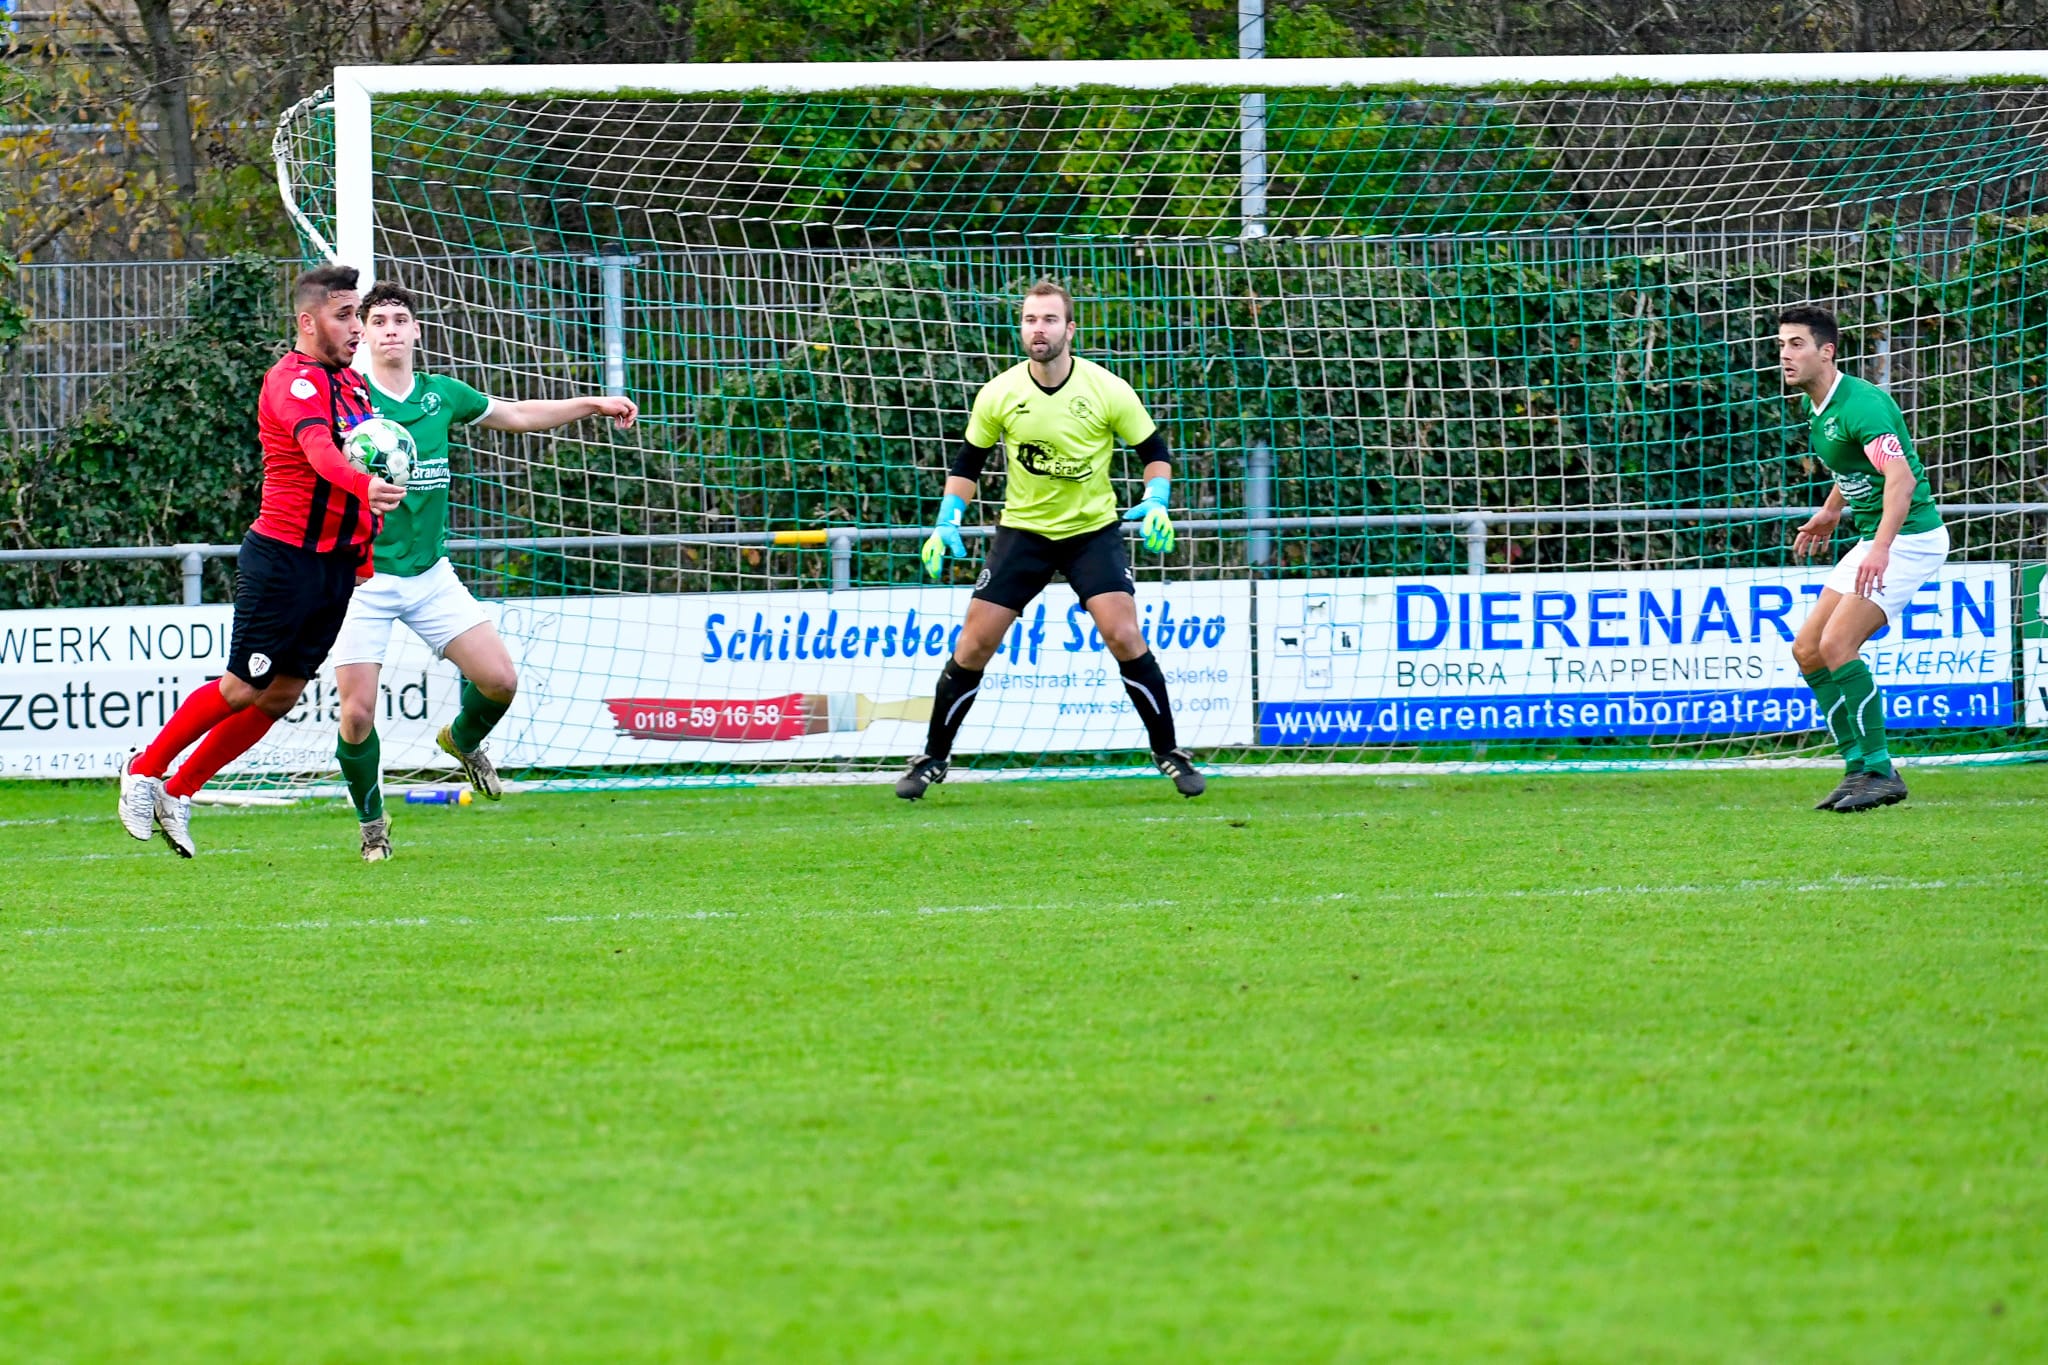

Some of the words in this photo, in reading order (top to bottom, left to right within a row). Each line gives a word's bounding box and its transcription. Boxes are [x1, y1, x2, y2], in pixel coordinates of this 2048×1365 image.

[1396, 580, 1995, 651] DIERENAREN
[0, 625, 111, 664] WERK
[129, 623, 225, 661] NODI
[702, 602, 1046, 665] Schildersbejf
[1064, 600, 1226, 652] Sciboo
[978, 671, 1077, 690] olenstraat
[1084, 669, 1107, 687] 22
[1165, 666, 1228, 685] skerke
[1397, 661, 1508, 687] BORRA
[1544, 655, 1763, 684] TRAPPENIERS
[724, 705, 748, 727] 16
[753, 704, 779, 726] 58
[1058, 696, 1230, 716] www.sco.com
[1275, 686, 1999, 735] www.dierenartsenborratrappiers.nl
[24, 755, 44, 773] 21
[50, 753, 70, 773] 47
[77, 754, 96, 773] 21
[103, 752, 124, 772] 40
